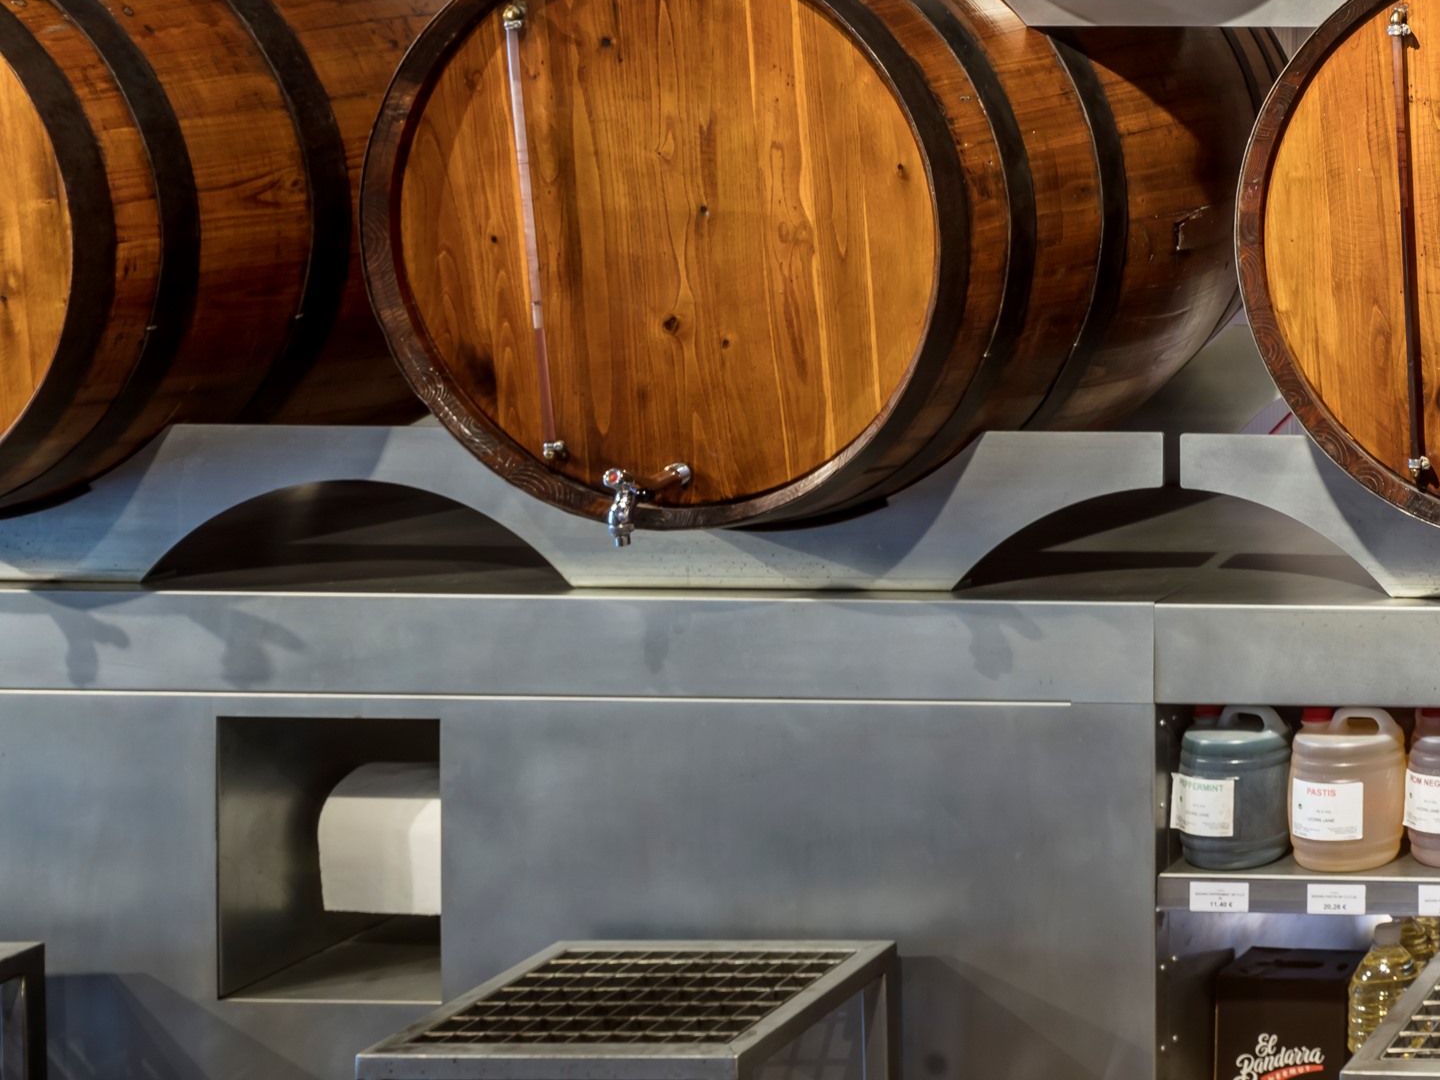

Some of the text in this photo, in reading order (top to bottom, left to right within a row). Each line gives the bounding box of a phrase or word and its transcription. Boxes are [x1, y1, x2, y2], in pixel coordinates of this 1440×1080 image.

[1179, 778, 1224, 792] PEPPERMINT
[1306, 787, 1337, 797] PASTIS
[1255, 1032, 1278, 1057] El
[1233, 1045, 1326, 1080] Bandarra
